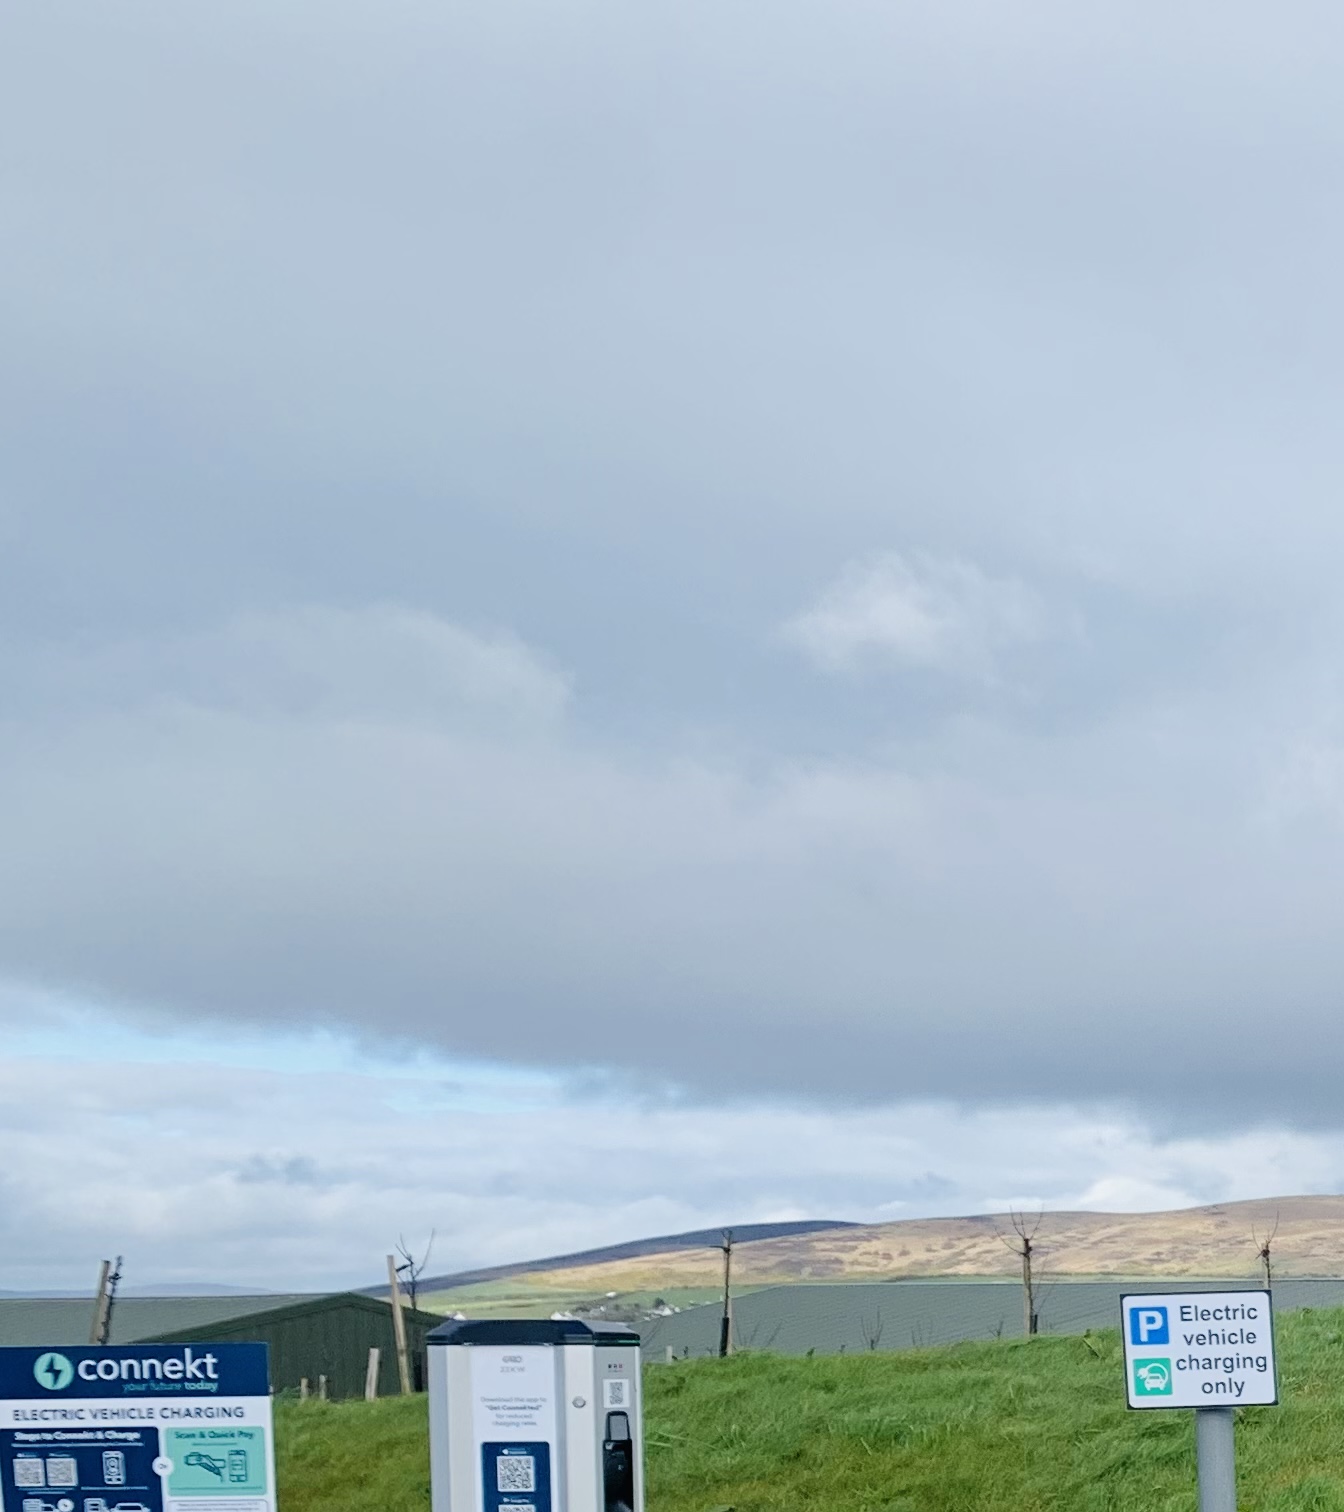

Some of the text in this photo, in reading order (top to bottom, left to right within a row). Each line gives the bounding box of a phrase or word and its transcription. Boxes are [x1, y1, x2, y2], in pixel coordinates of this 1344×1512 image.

[1179, 1304, 1259, 1322] Electric
[1138, 1310, 1164, 1342] P
[1183, 1328, 1257, 1346] vehicle
[77, 1347, 219, 1380] connekt
[1176, 1353, 1267, 1373] charging
[183, 1380, 219, 1393] today
[1201, 1378, 1245, 1397] only
[12, 1405, 246, 1421] ELECTRIC VEHICLE CHARGING
